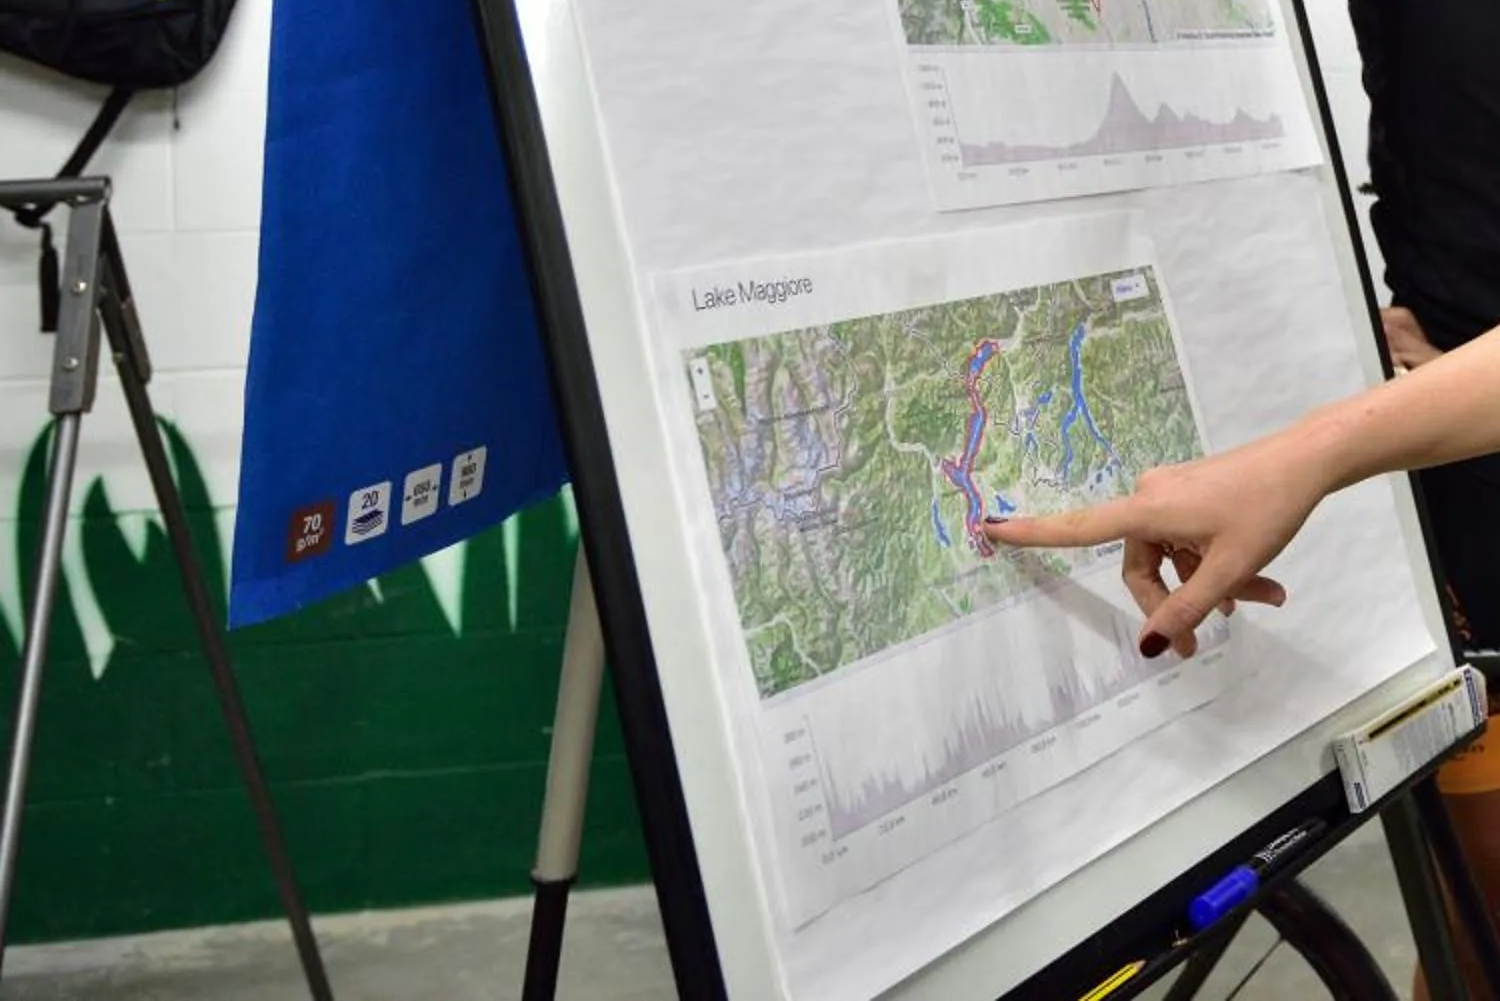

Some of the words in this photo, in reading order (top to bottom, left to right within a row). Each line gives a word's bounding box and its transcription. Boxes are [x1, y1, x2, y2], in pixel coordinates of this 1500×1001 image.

[692, 286, 737, 311] Lake
[737, 276, 813, 304] Maggiore
[361, 490, 379, 510] 20
[303, 512, 322, 534] 70
